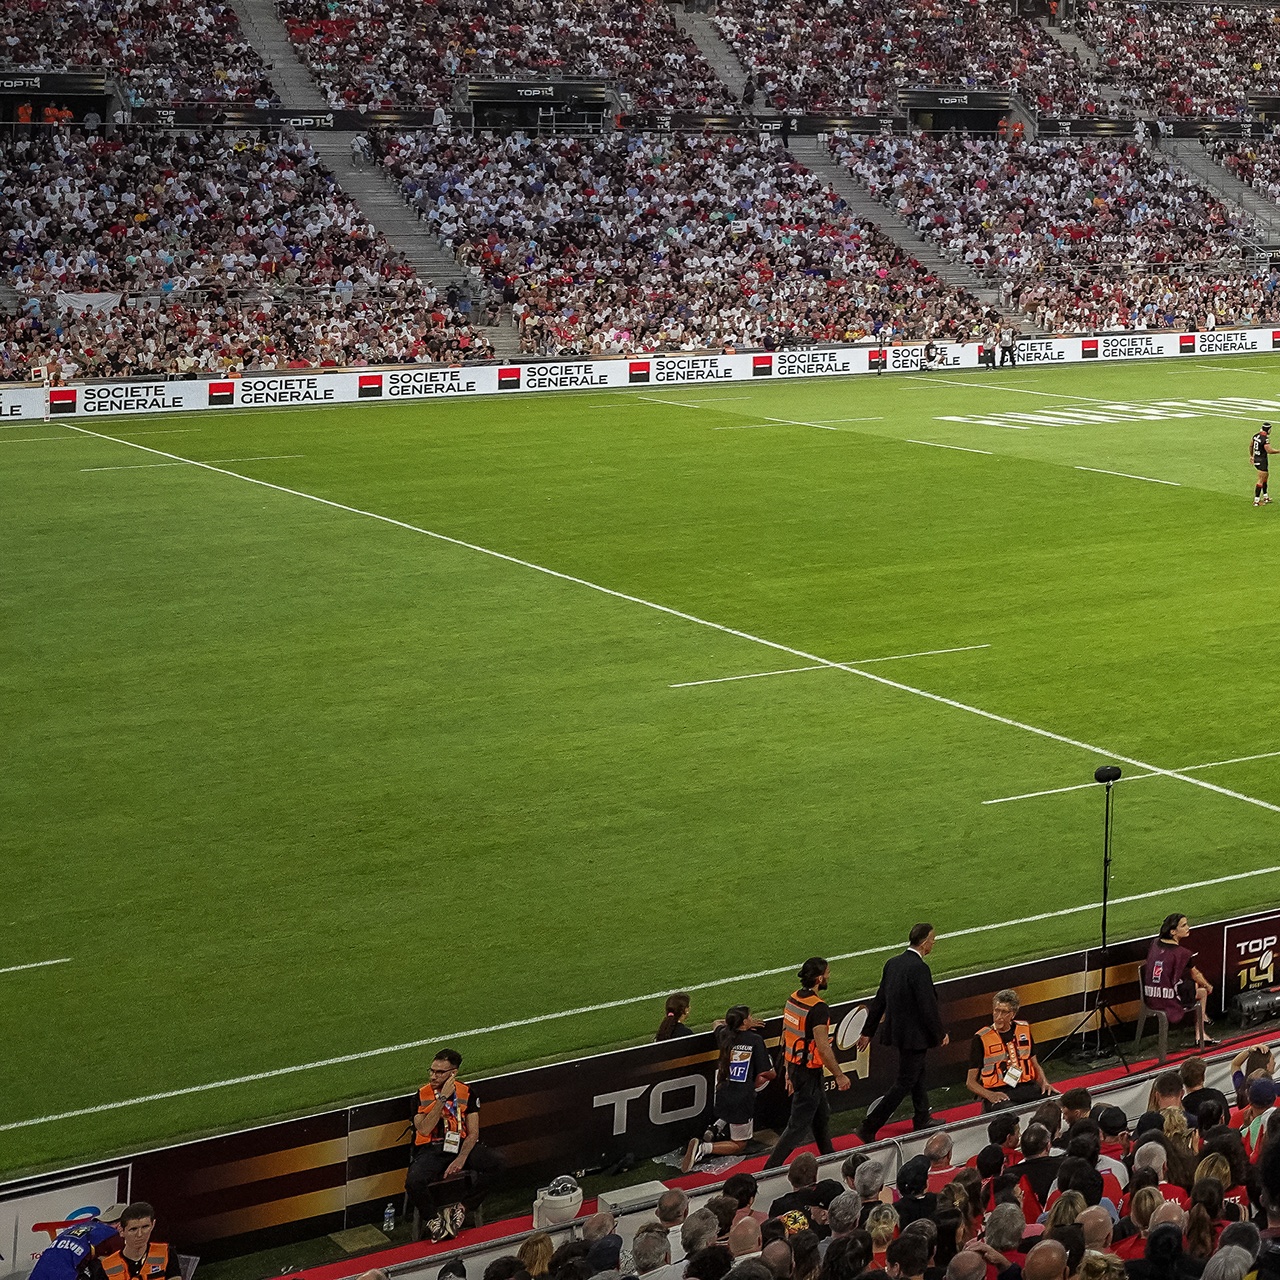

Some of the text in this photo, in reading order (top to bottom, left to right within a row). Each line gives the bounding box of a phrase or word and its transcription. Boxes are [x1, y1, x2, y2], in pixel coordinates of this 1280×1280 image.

[1103, 337, 1153, 348] SOCIETE
[1199, 332, 1247, 343] SOCIETE
[1102, 346, 1164, 357] GENERALE
[1199, 341, 1258, 352] GENERALE
[656, 358, 718, 371] SOCIETE
[778, 352, 836, 364] SOCIETE
[527, 364, 594, 377] SOCIETE
[655, 368, 733, 382] GENERALE
[777, 362, 850, 375] GENERALE
[389, 370, 460, 384] SOCIETE
[526, 374, 608, 388] GENERALE
[241, 378, 318, 392] SOCIETE
[389, 381, 476, 396] GENERALE
[84, 385, 166, 400] SOCIETE
[241, 389, 335, 404] GENERALE
[83, 396, 183, 412] GENERALE
[1236, 935, 1278, 955] TOP
[1237, 963, 1275, 990] 14
[58, 1239, 85, 1257] CLUB
